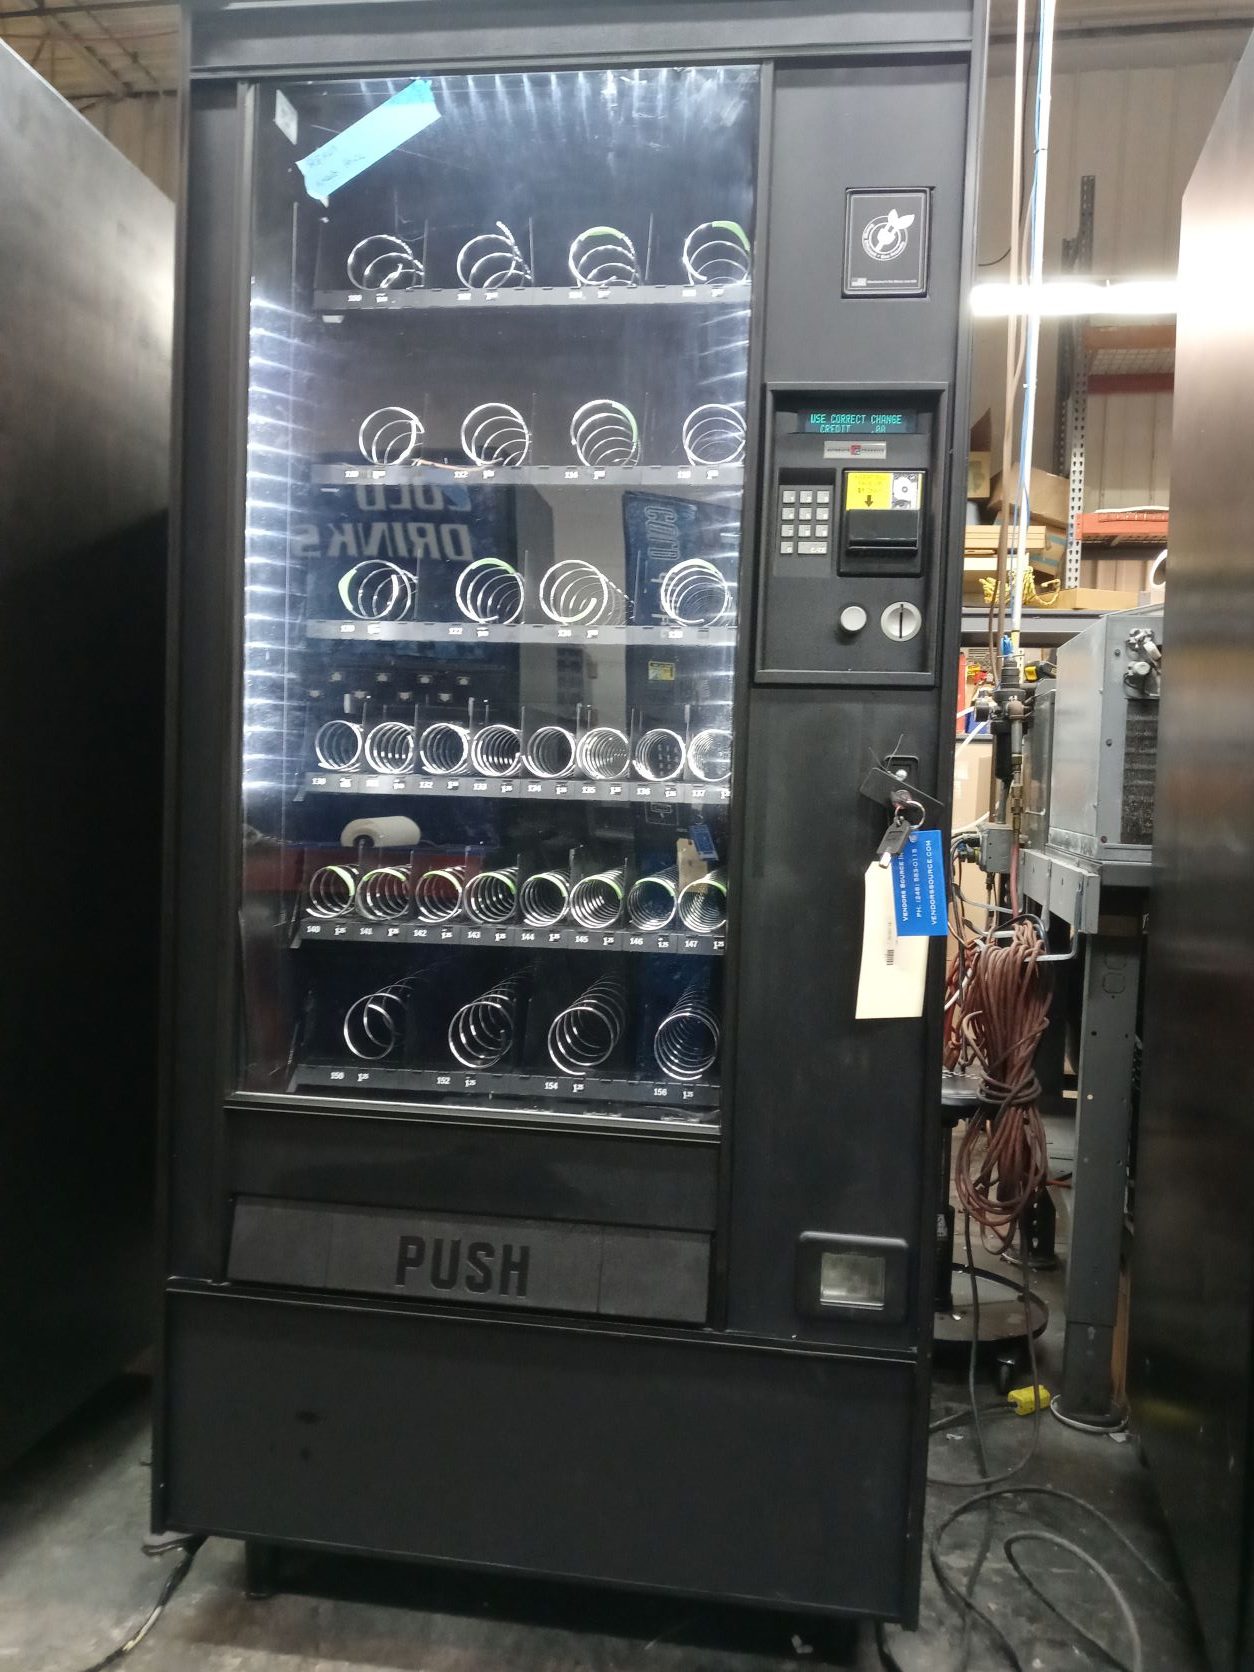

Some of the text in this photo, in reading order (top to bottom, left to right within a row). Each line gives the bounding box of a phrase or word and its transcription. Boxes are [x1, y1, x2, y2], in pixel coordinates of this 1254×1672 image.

[811, 414, 903, 425] USE CORRECT CHANGE
[820, 425, 851, 434] CREDIT
[898, 861, 906, 889] SOURCE
[925, 840, 938, 925] VENDORSSOURCE.COM
[900, 890, 909, 922] VENDORS
[574, 935, 589, 944] 145
[629, 937, 644, 946] 146
[684, 939, 699, 948] 147
[544, 1081, 559, 1090] 154
[653, 1087, 668, 1097] 156
[395, 1235, 531, 1299] PUSH
